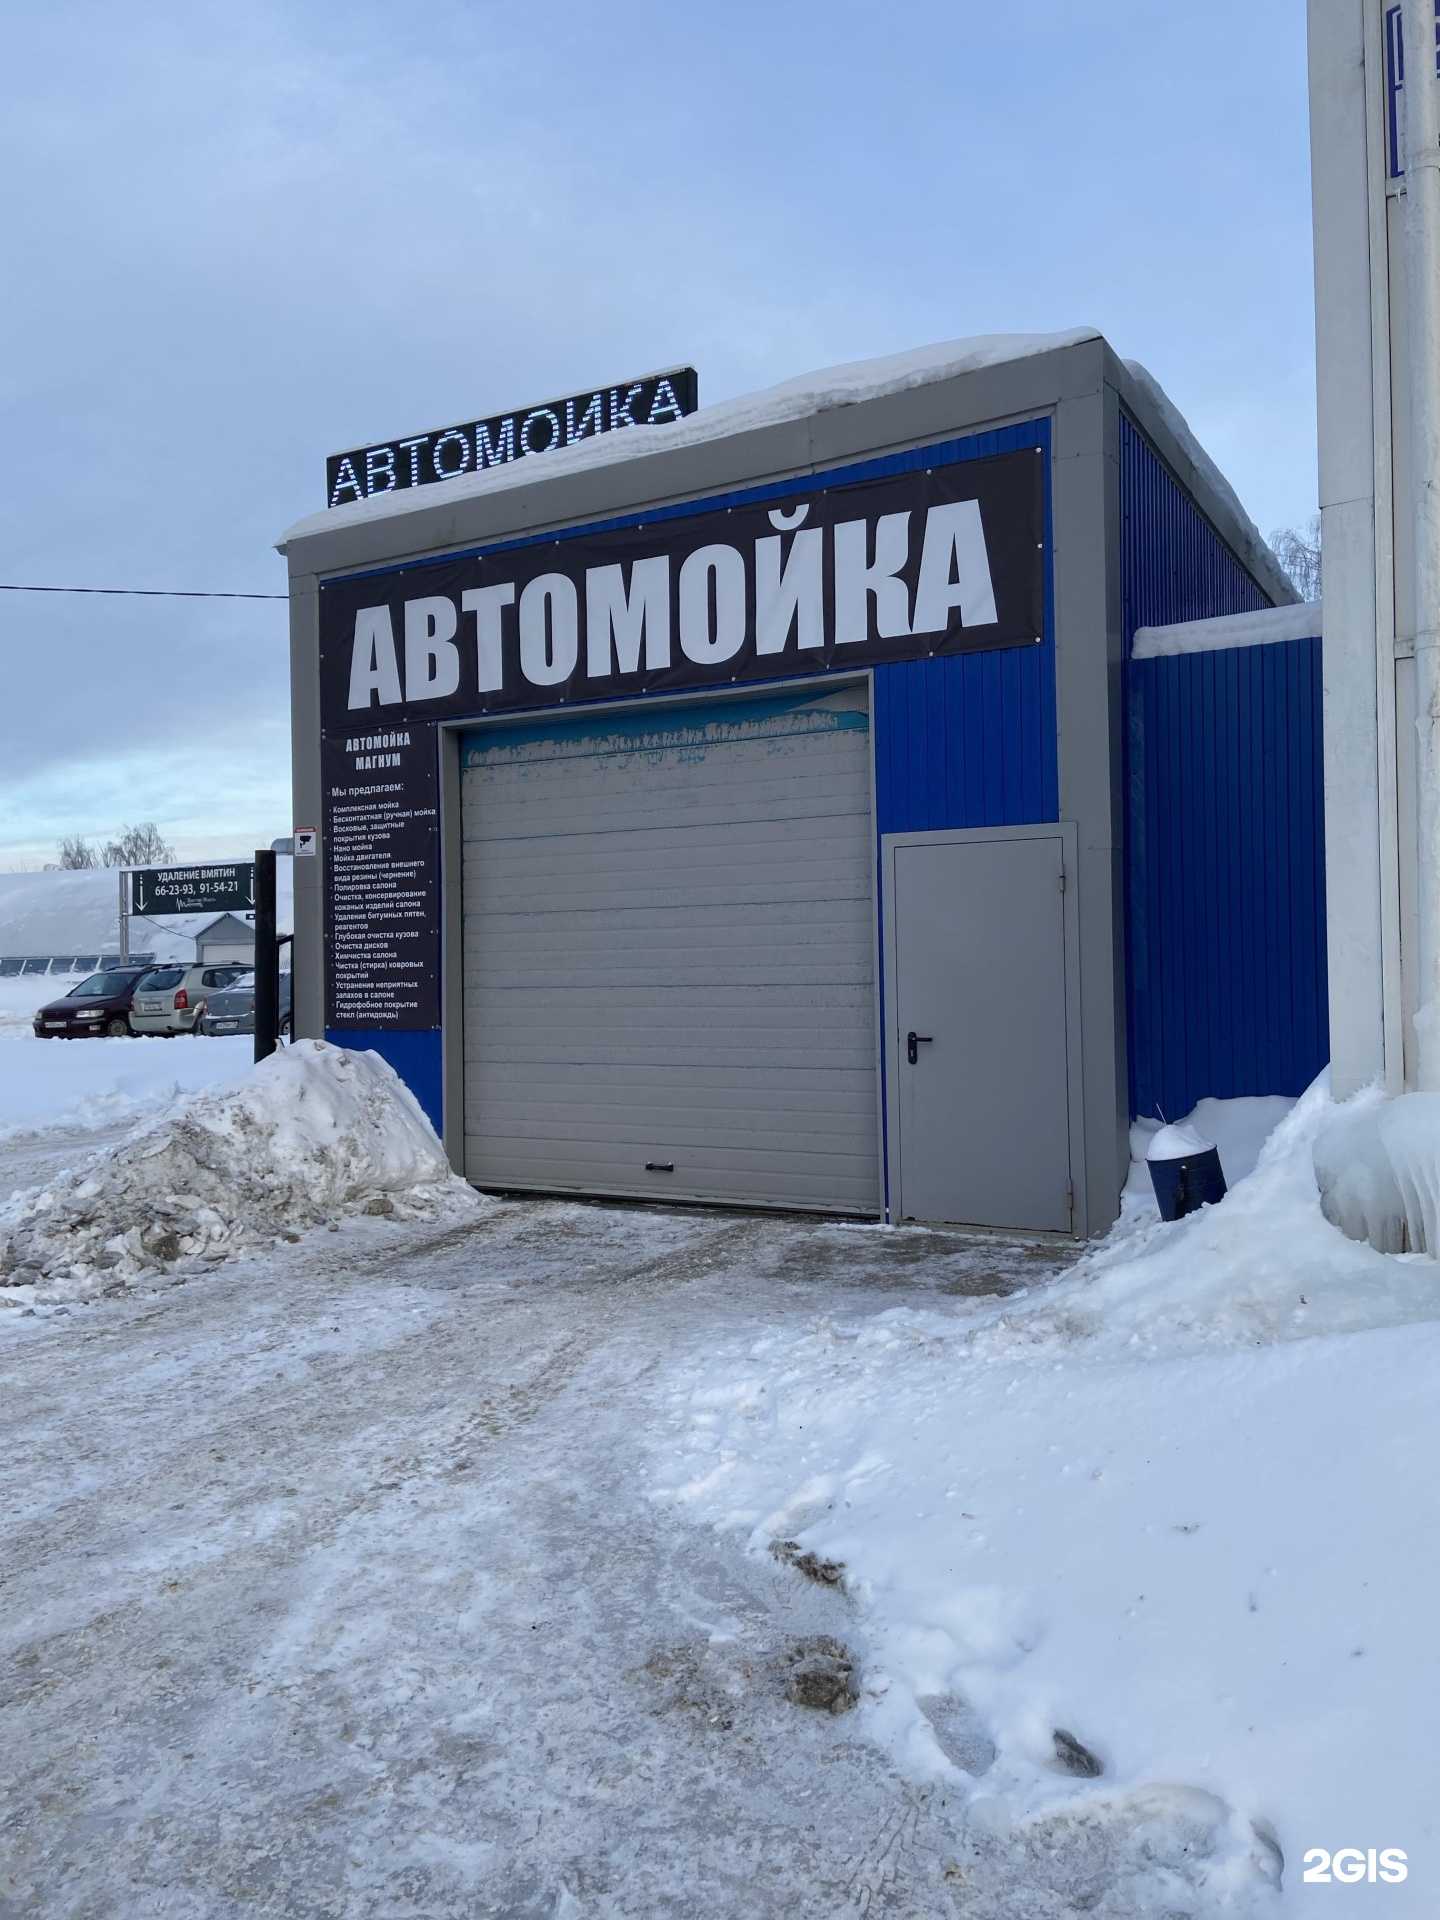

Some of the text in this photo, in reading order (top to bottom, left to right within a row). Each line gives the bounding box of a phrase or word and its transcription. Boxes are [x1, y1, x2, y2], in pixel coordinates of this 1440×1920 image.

[347, 498, 999, 710] АВТОМОЙКА
[346, 732, 410, 752] АВТОМОЙКА
[356, 753, 400, 770] МАГНУМ
[332, 784, 404, 796] Мы предлагаем:
[333, 801, 399, 813] Комплексная мойка
[334, 813, 382, 823] Бесконтактная
[414, 808, 436, 816] мойка
[370, 821, 404, 830] защитные
[368, 832, 390, 841] кузова
[158, 868, 236, 882] УДАЛЕНИЕ ВМЯТИН
[155, 882, 238, 896] 66-23-93, 91-54-21
[335, 884, 370, 892] Полировка
[368, 911, 402, 920] битумных
[335, 932, 365, 941] Глубокая
[396, 931, 418, 939] кузова
[335, 942, 362, 950] Очистка
[335, 952, 371, 960] Химчистка
[336, 981, 374, 989] Устранение
